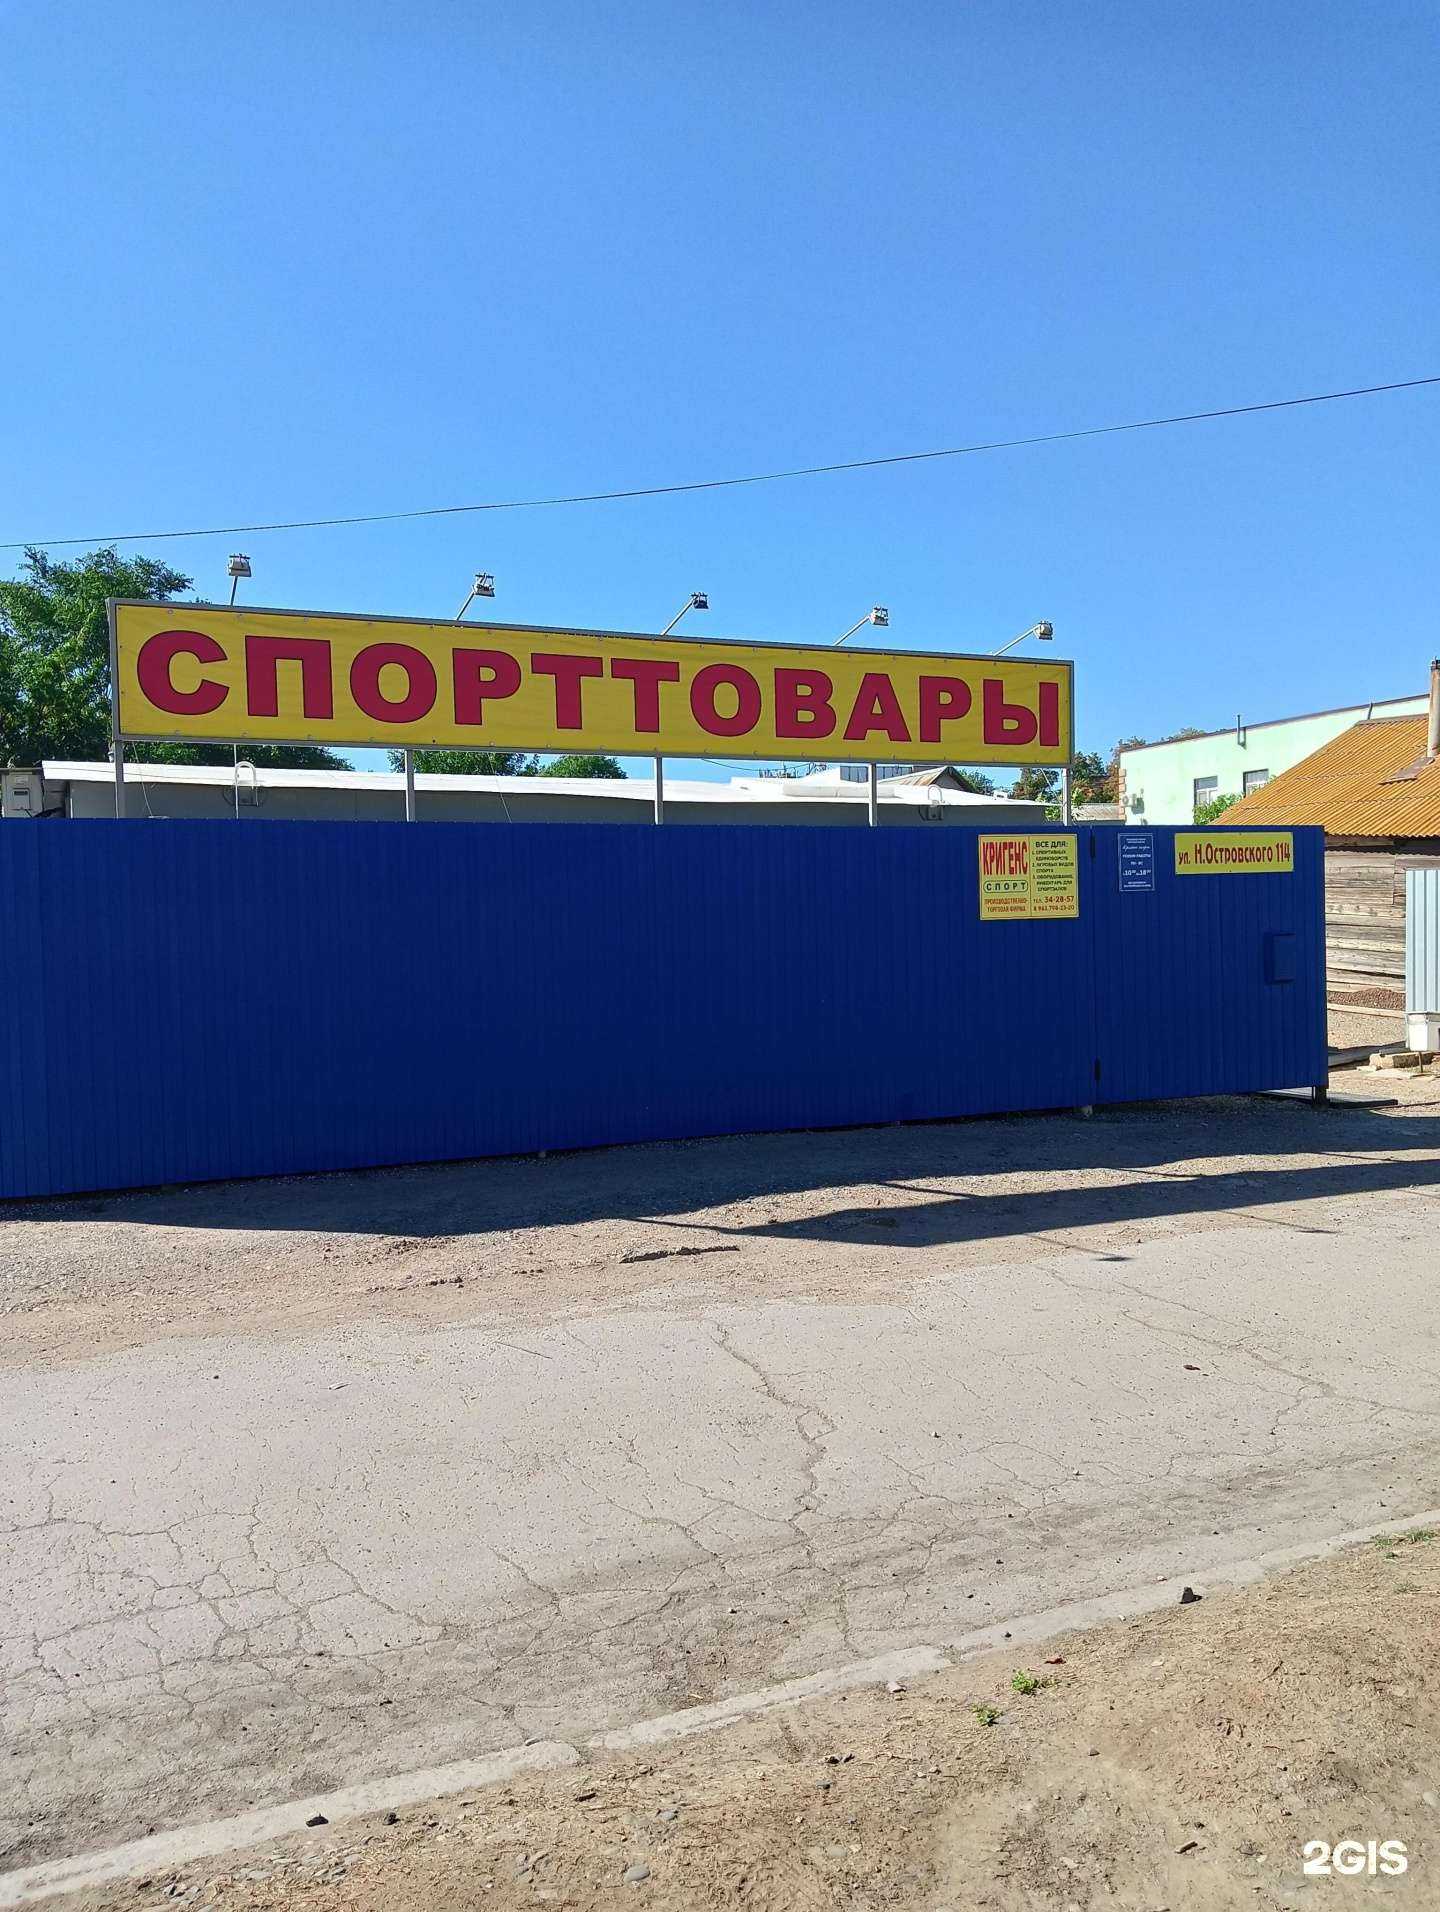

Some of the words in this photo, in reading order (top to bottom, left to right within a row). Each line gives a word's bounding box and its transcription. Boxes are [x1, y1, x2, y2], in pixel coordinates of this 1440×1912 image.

[137, 630, 1059, 747] СПОРТТОВАРЫ
[983, 841, 1028, 875] КРИГЕНС
[1178, 851, 1191, 865] ул.
[1275, 842, 1290, 862] 114
[986, 883, 1026, 891] СПОРТ
